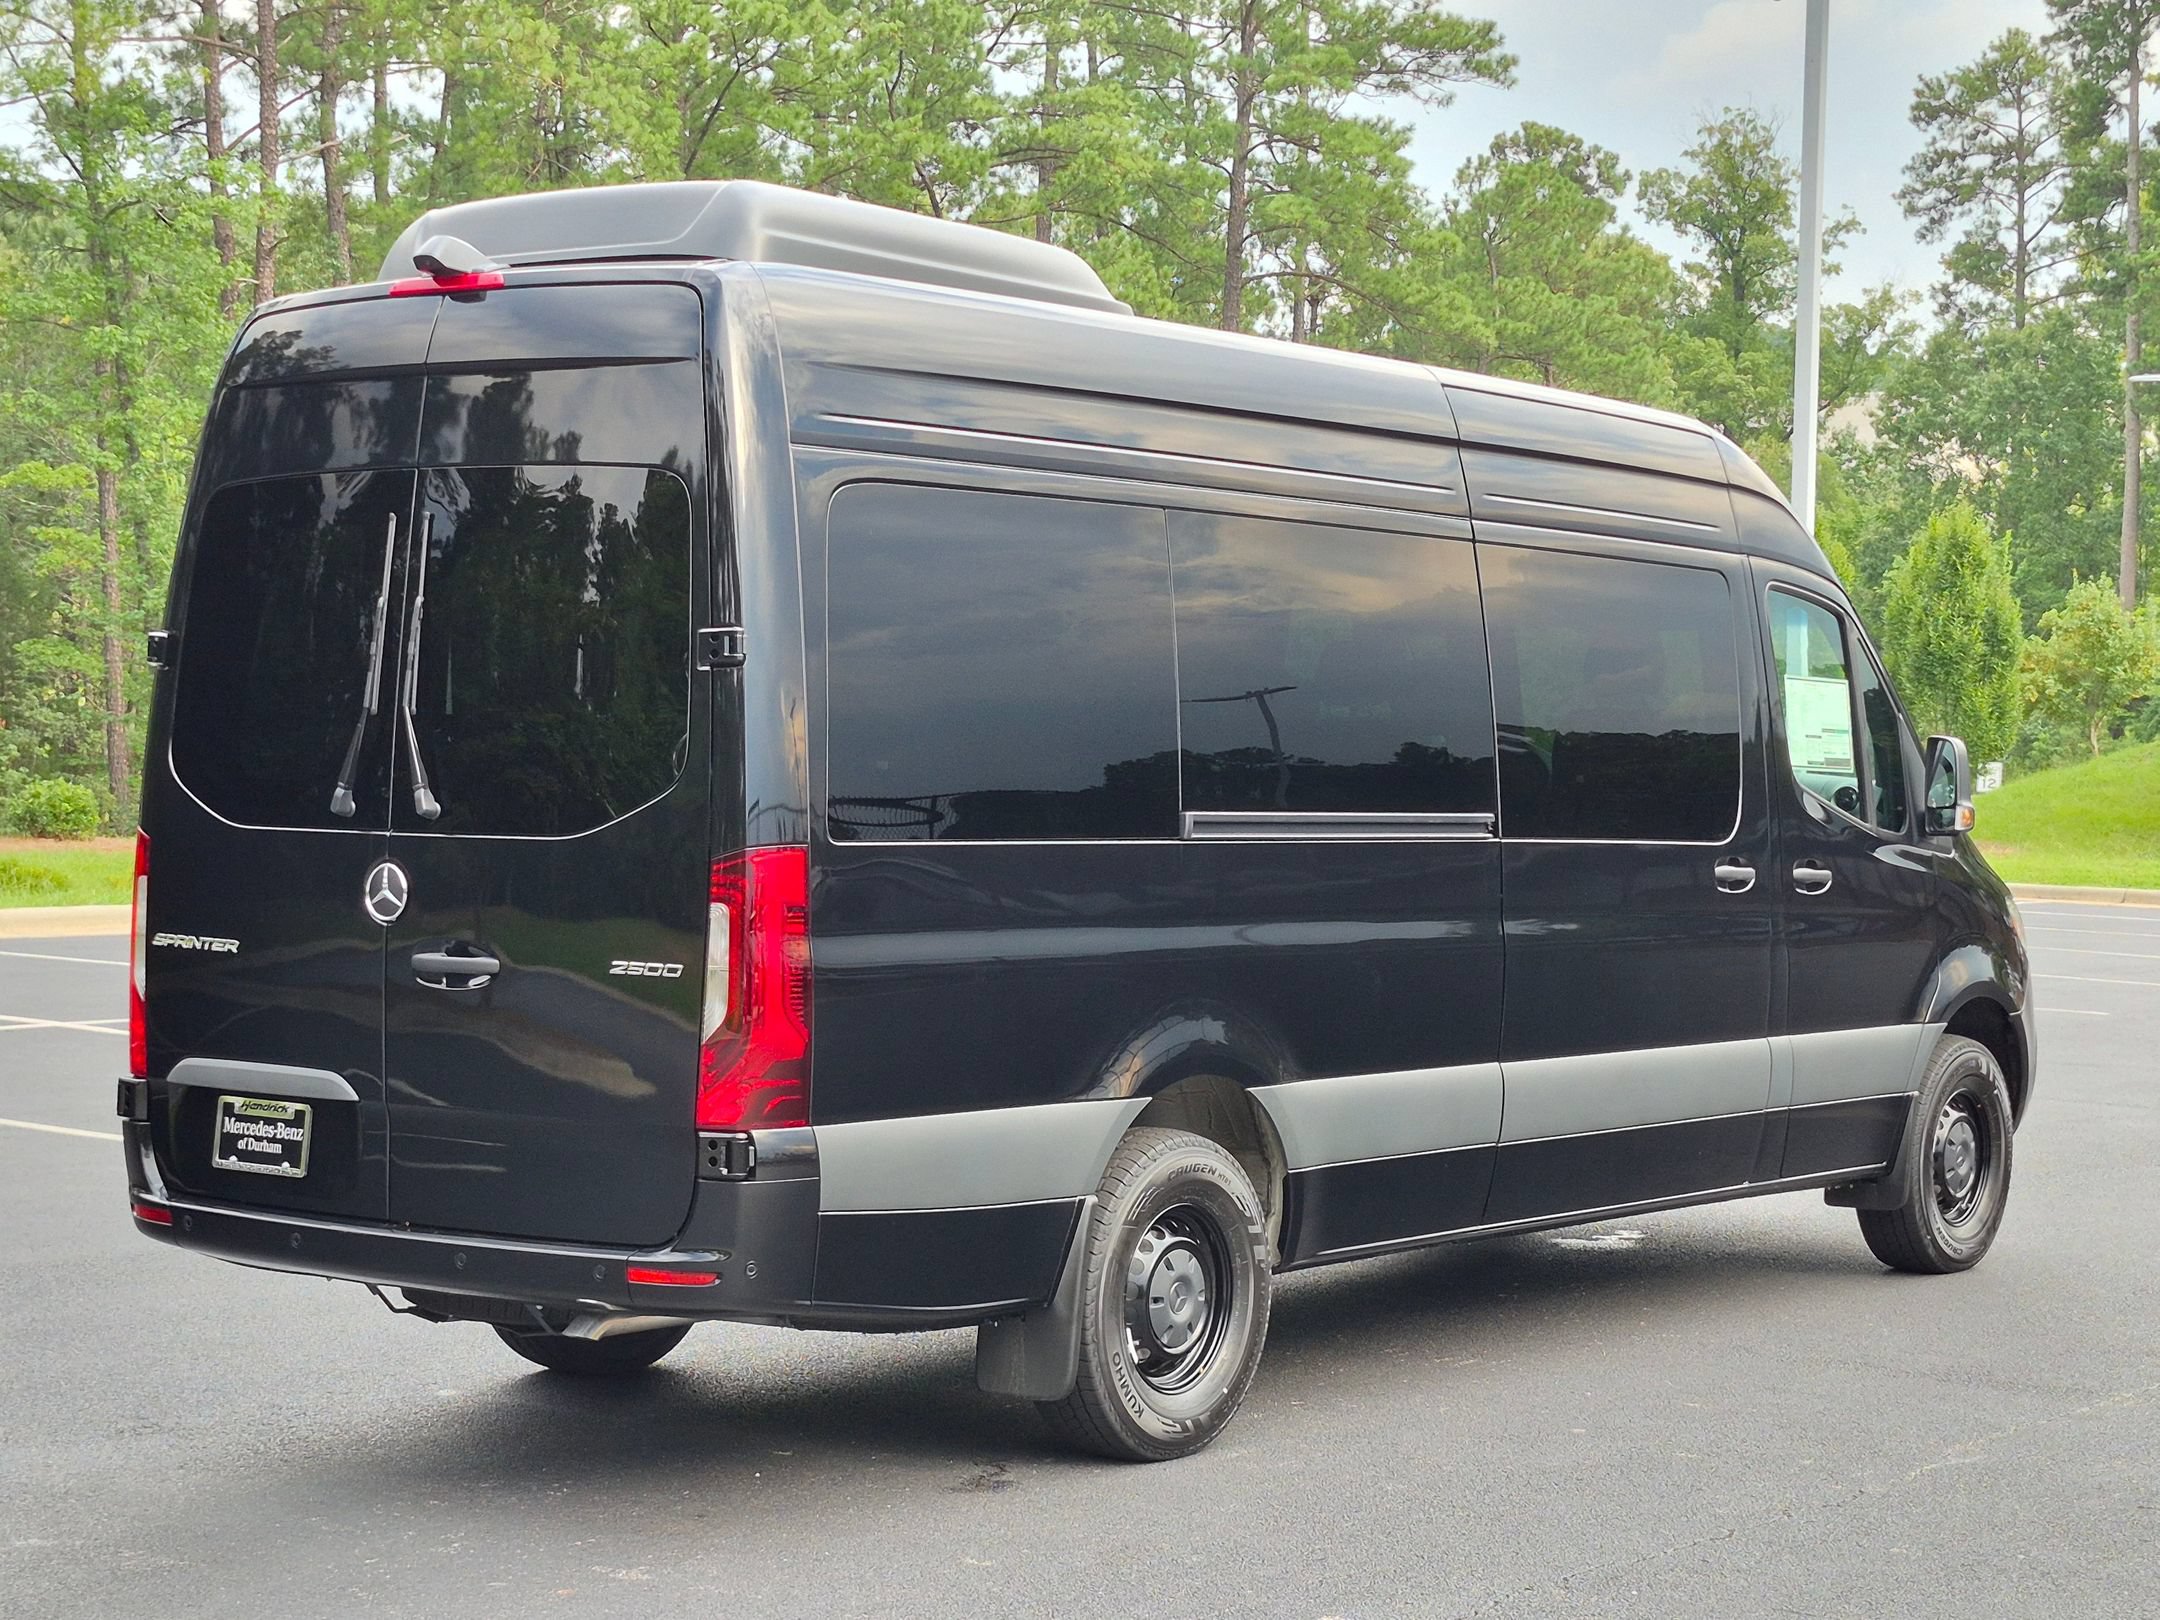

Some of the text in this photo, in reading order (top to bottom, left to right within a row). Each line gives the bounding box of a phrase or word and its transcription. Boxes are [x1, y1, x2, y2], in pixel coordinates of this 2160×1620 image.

[152, 932, 240, 954] SPRINTER
[609, 960, 684, 978] 2500
[240, 1100, 290, 1113] Hendrick
[223, 1116, 304, 1142] Mercedes-Benz
[237, 1137, 282, 1154] of Durham
[1112, 1351, 1145, 1419] KUMHO
